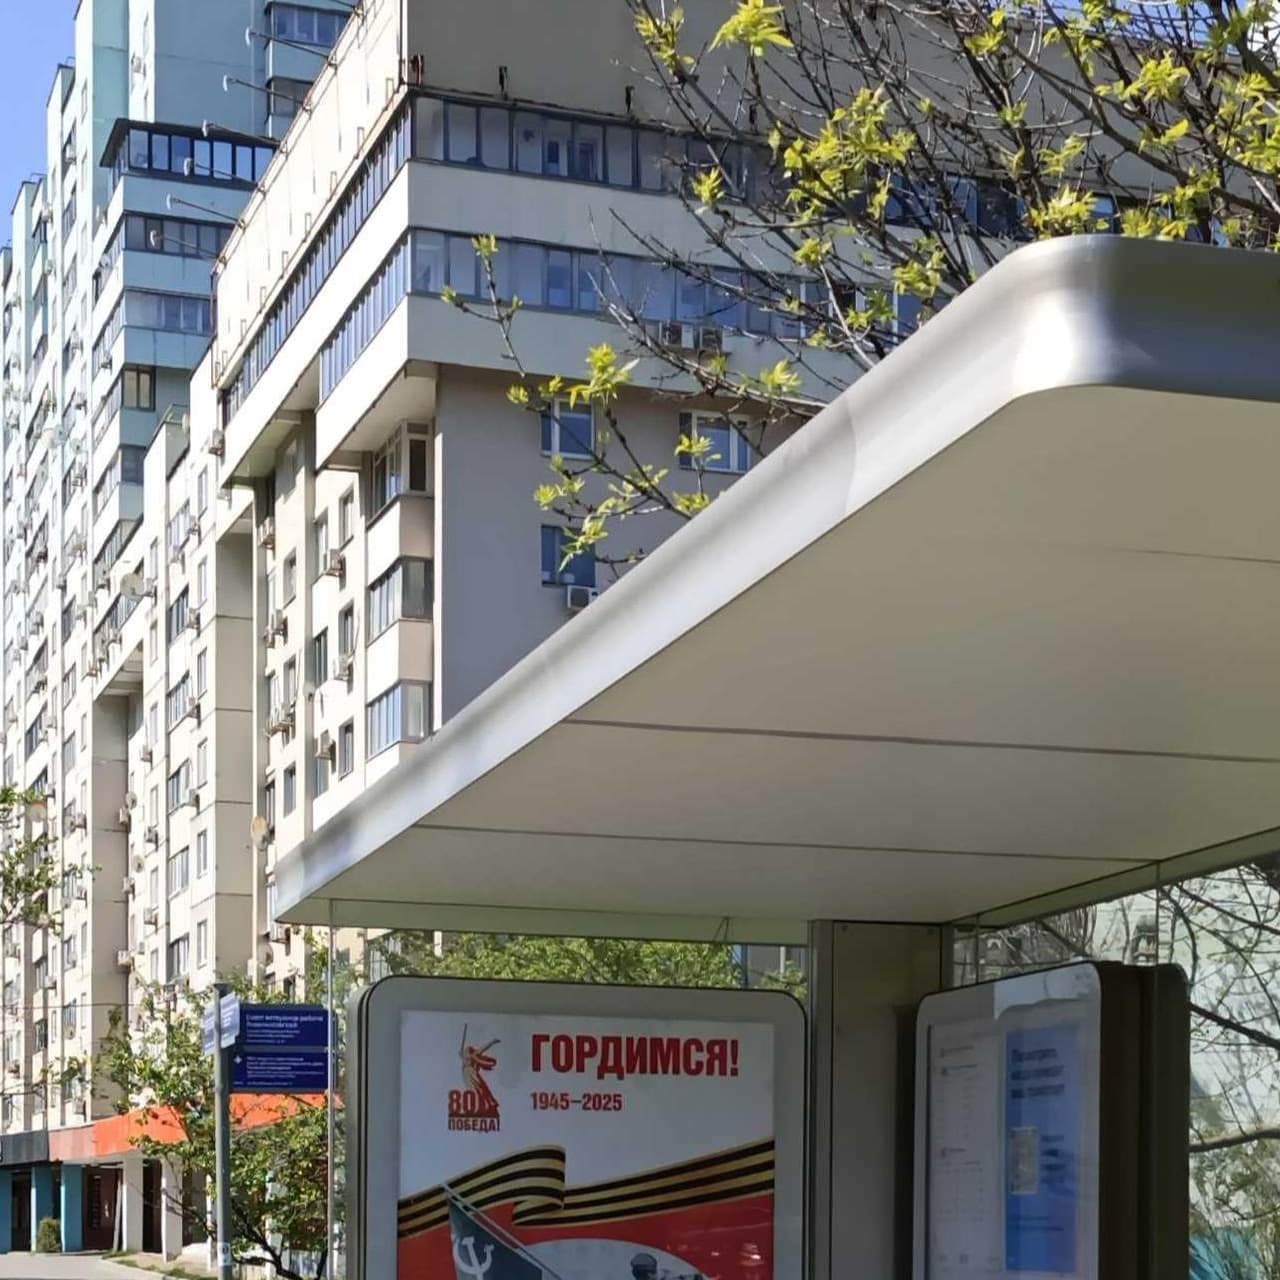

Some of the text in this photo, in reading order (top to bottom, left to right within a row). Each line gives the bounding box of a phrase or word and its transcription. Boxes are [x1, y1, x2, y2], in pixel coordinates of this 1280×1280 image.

[532, 1034, 739, 1080] ГОРДИМСЯ!
[448, 1089, 476, 1113] 80
[448, 1119, 500, 1133] ПОБЕДА!
